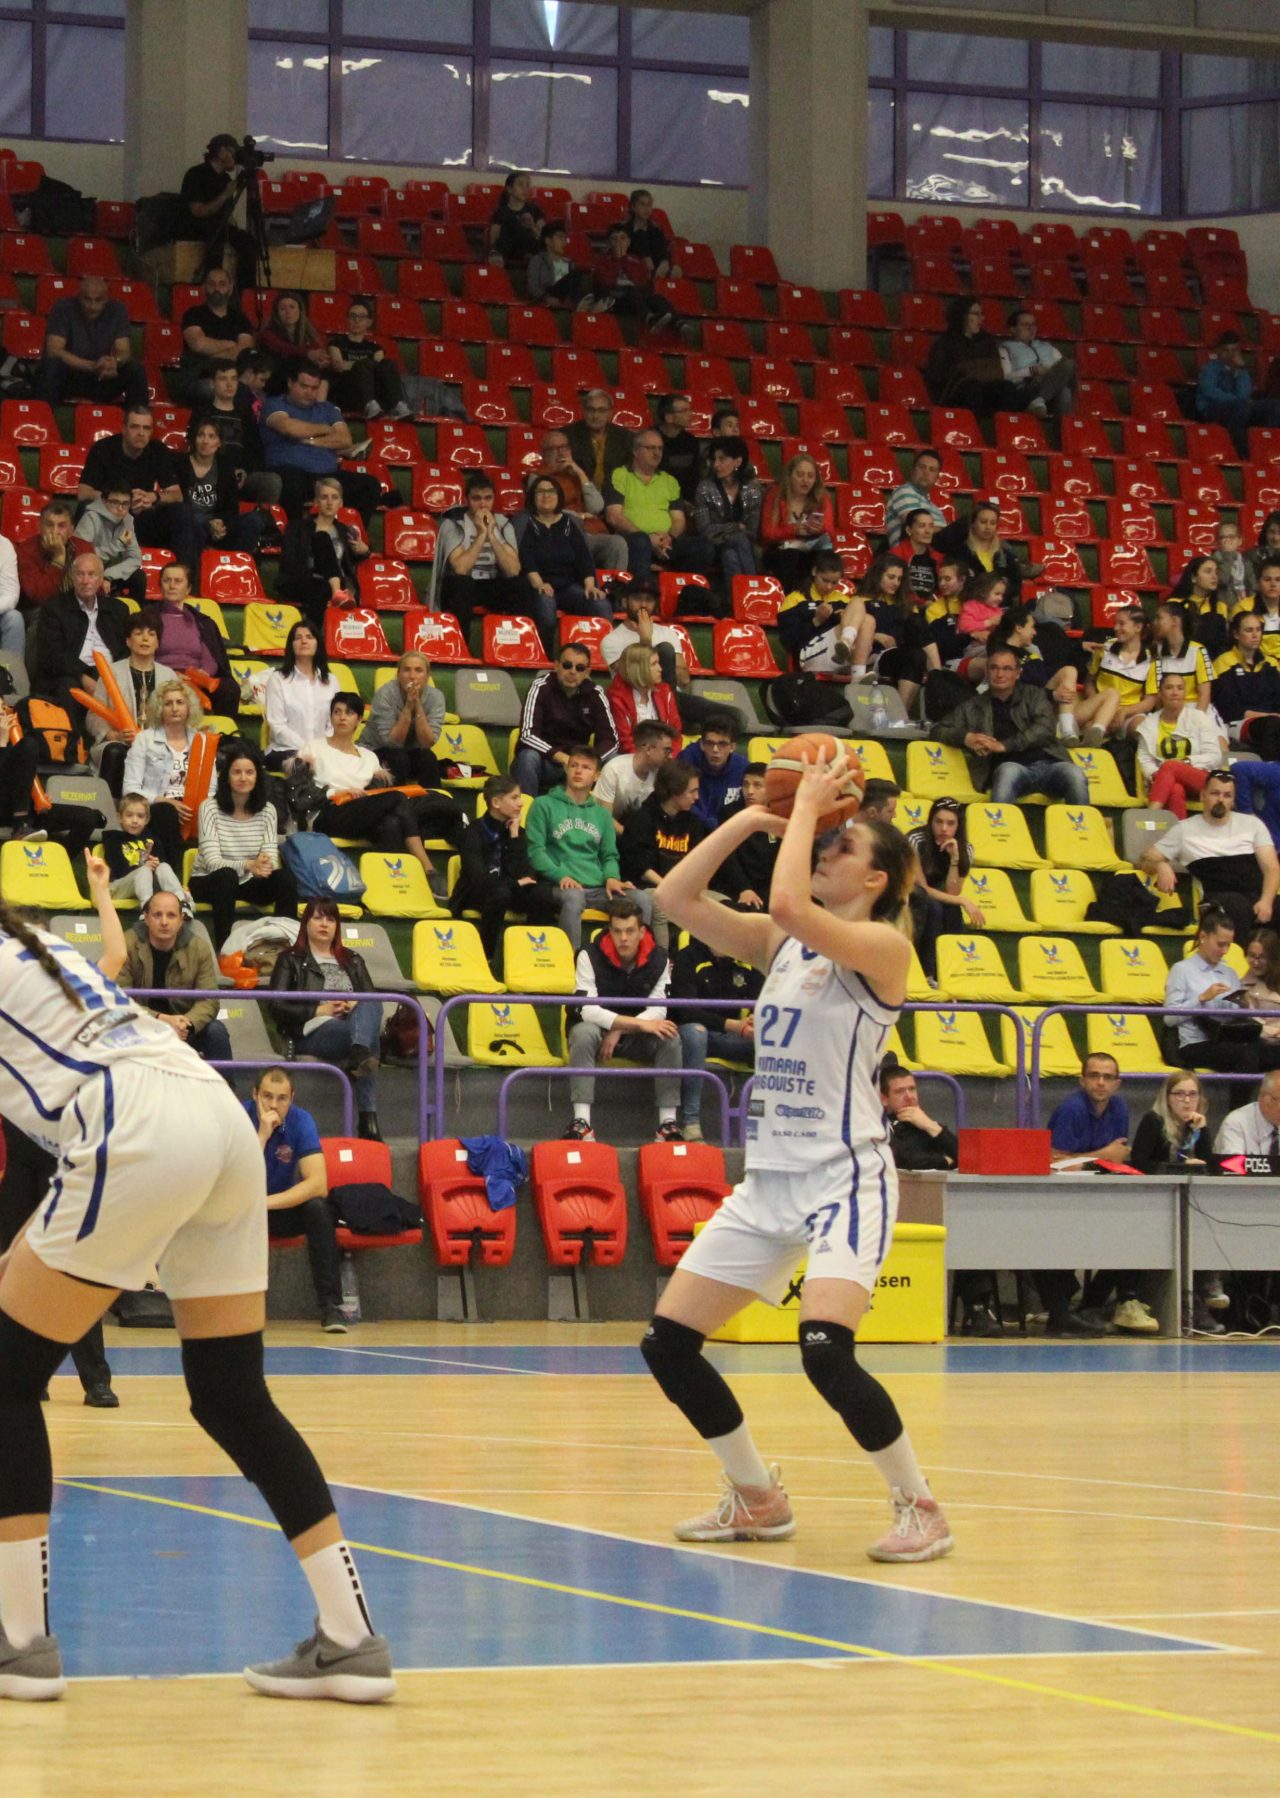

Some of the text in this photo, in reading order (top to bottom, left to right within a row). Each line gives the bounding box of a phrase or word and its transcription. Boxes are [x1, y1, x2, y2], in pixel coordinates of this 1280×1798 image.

[61, 792, 97, 801] REZERVAT
[65, 932, 102, 942] REZERVAT
[342, 938, 375, 948] EZERVAT
[760, 1005, 802, 1048] 27
